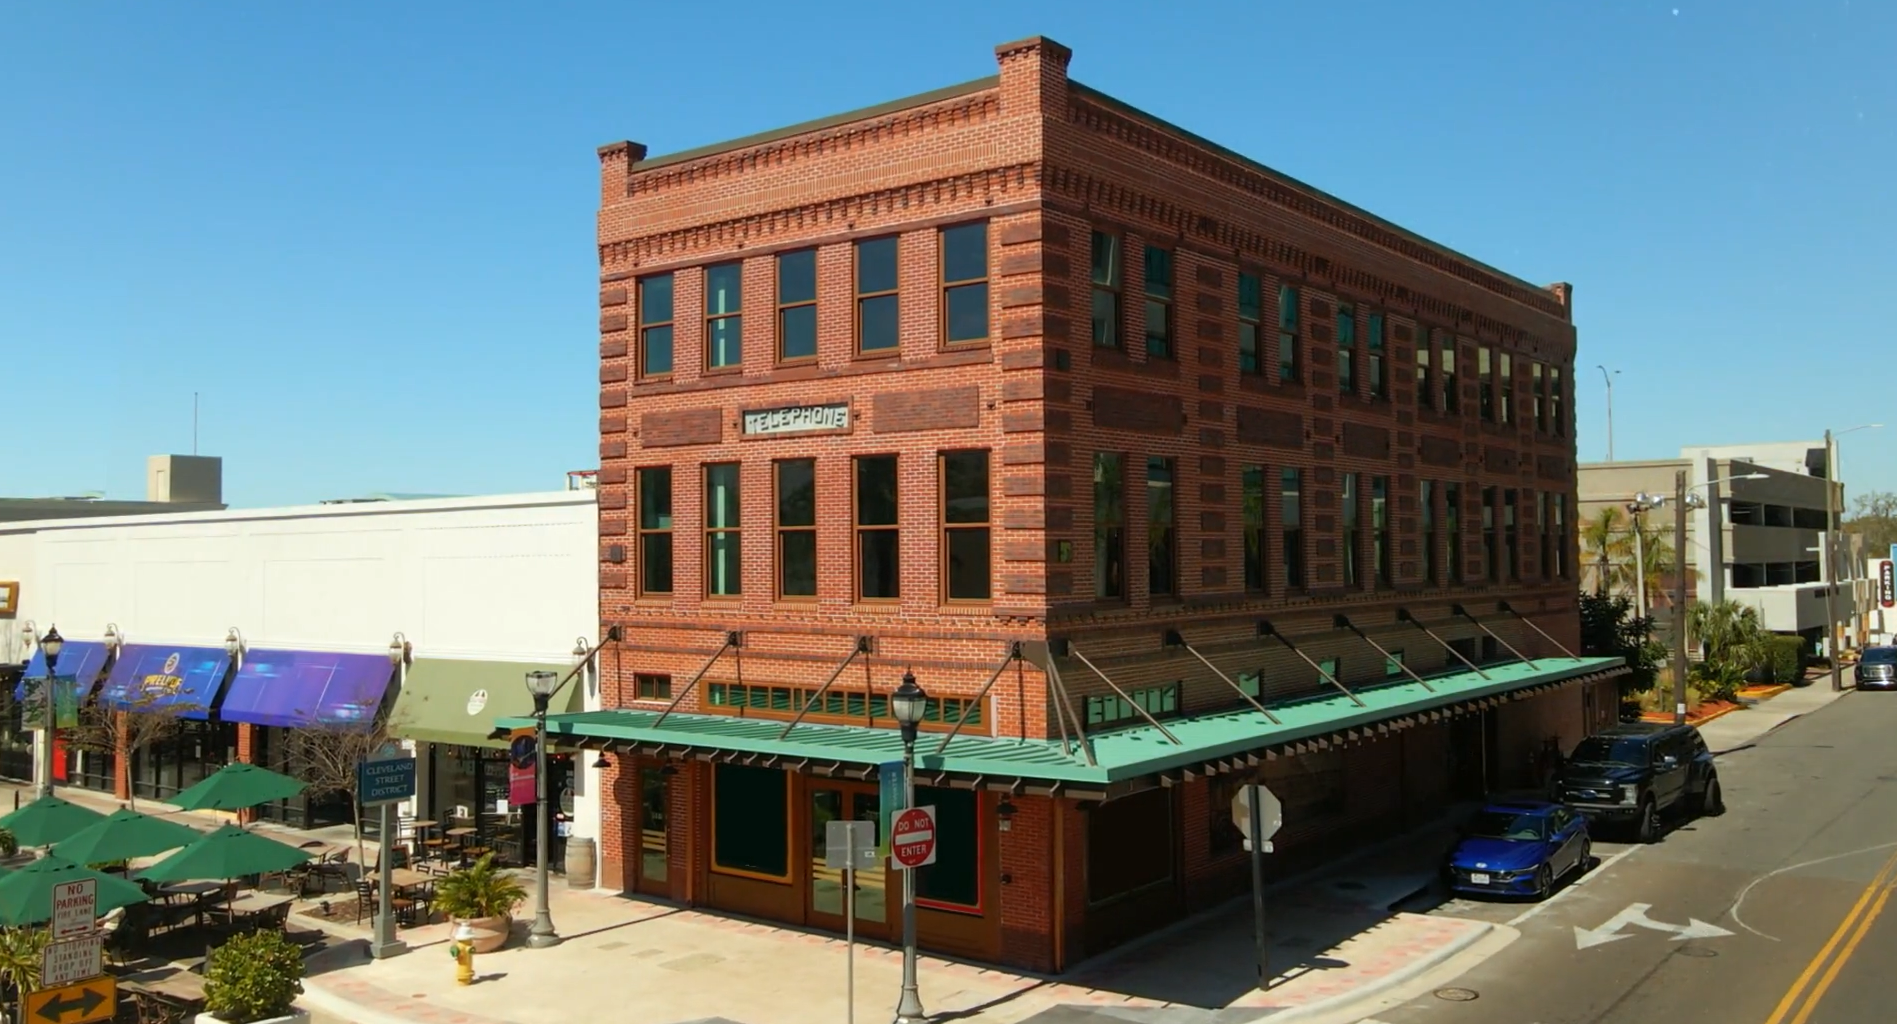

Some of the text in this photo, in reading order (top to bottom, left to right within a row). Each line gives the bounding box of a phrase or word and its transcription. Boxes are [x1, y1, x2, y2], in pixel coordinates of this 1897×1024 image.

[748, 406, 846, 434] TELEPHONE
[1883, 565, 1892, 600] PARKING
[366, 763, 413, 775] CLEVELAND
[375, 774, 404, 785] STREET
[371, 784, 408, 797] DISTRICT
[898, 817, 929, 831] DO NOT
[901, 844, 927, 857] ENTER
[67, 884, 83, 895] NO
[56, 894, 94, 910] PARKING
[57, 907, 92, 919] FIRE LANE
[63, 937, 100, 952] STOPPING
[54, 949, 93, 964] STANDING
[52, 958, 93, 974] DROP OFF
[54, 967, 91, 981] ANY TIME
